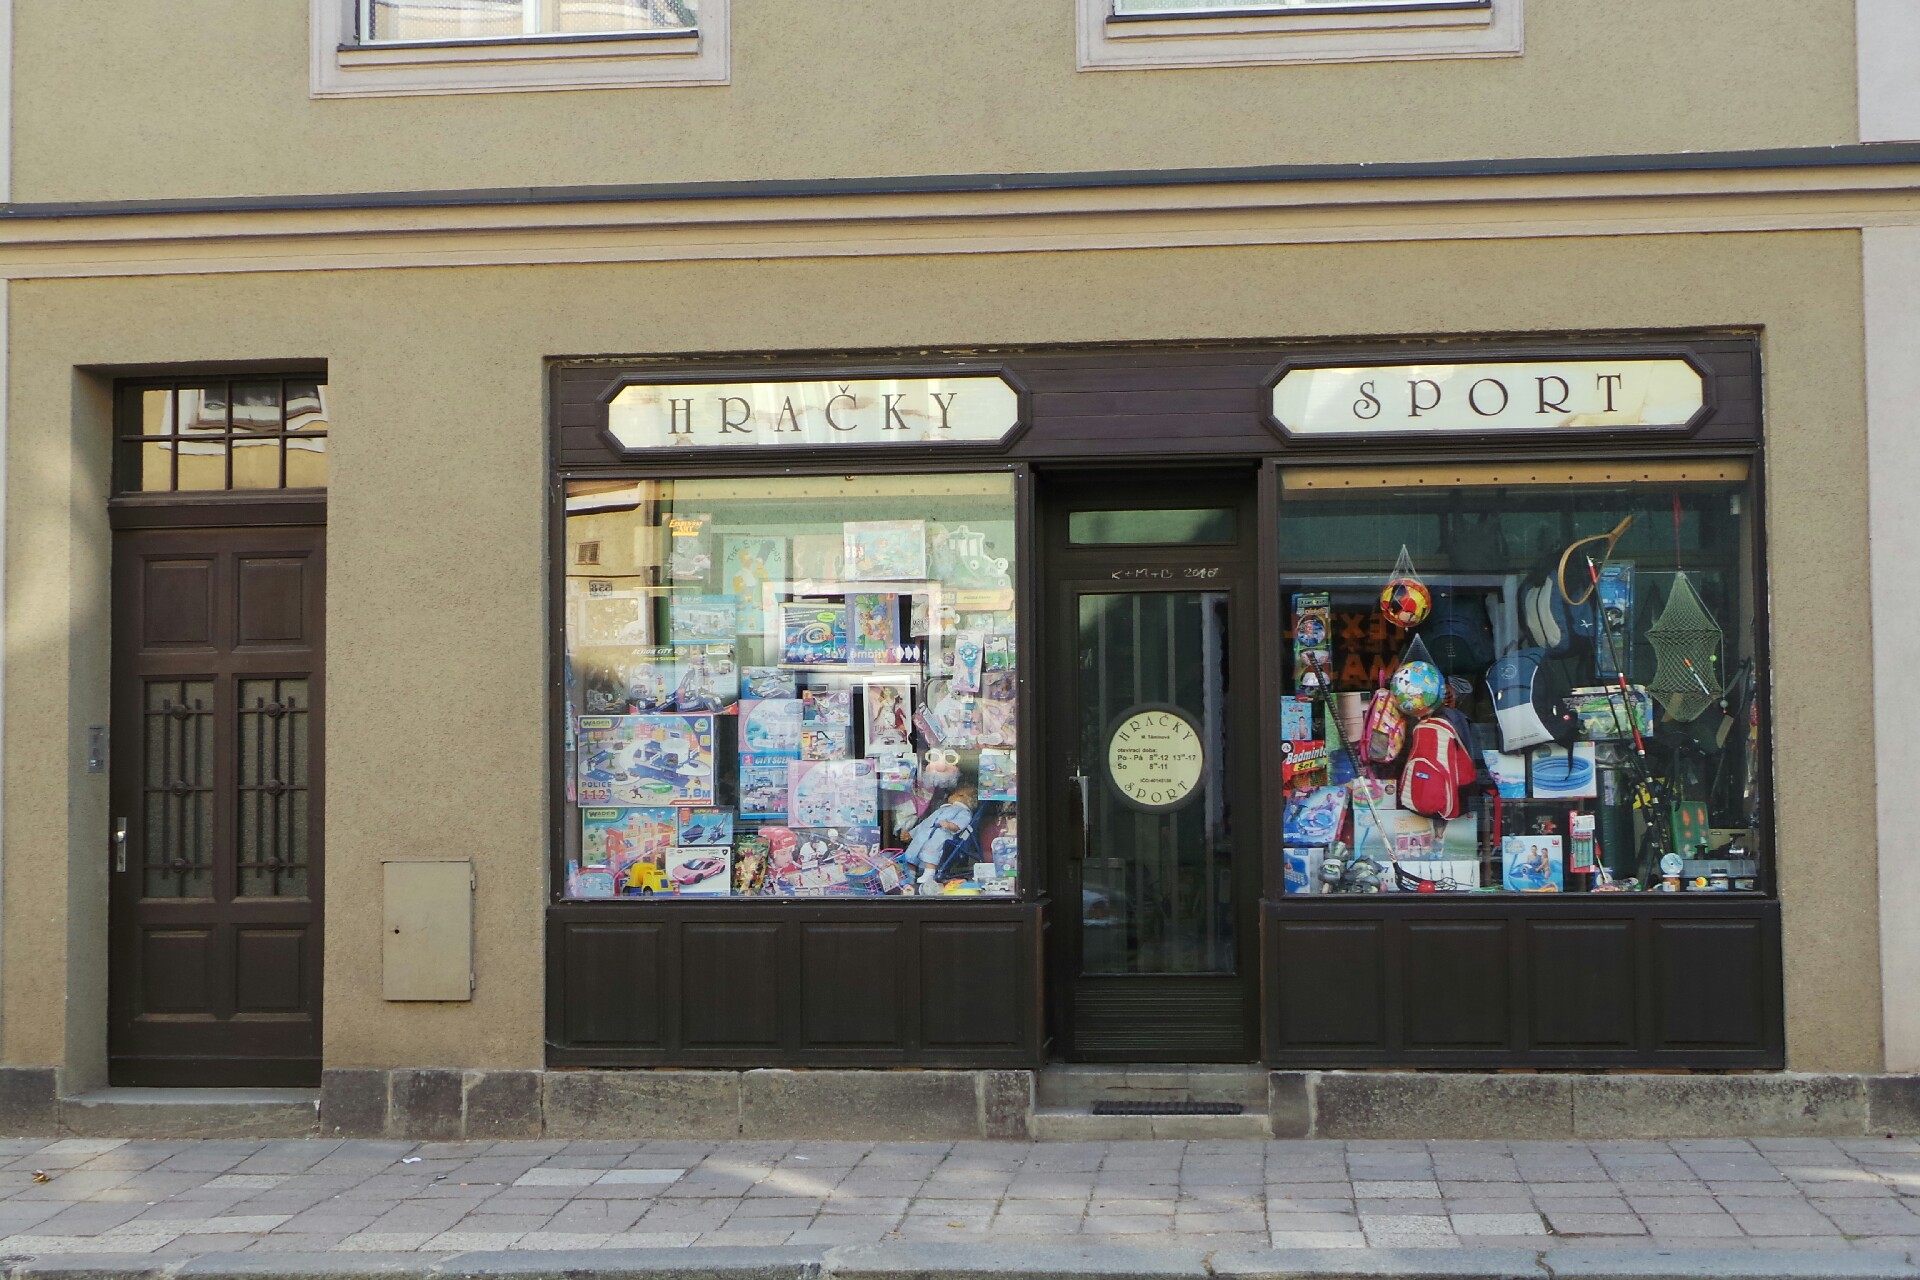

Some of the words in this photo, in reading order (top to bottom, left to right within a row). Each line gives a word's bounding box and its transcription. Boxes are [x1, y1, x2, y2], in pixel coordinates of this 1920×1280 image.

[1353, 373, 1622, 419] SPORT
[668, 384, 958, 434] HRAČKY
[1119, 714, 1193, 742] HRAČKY
[1286, 745, 1327, 765] Badminto
[582, 789, 606, 800] 112
[1124, 780, 1188, 803] SPORT
